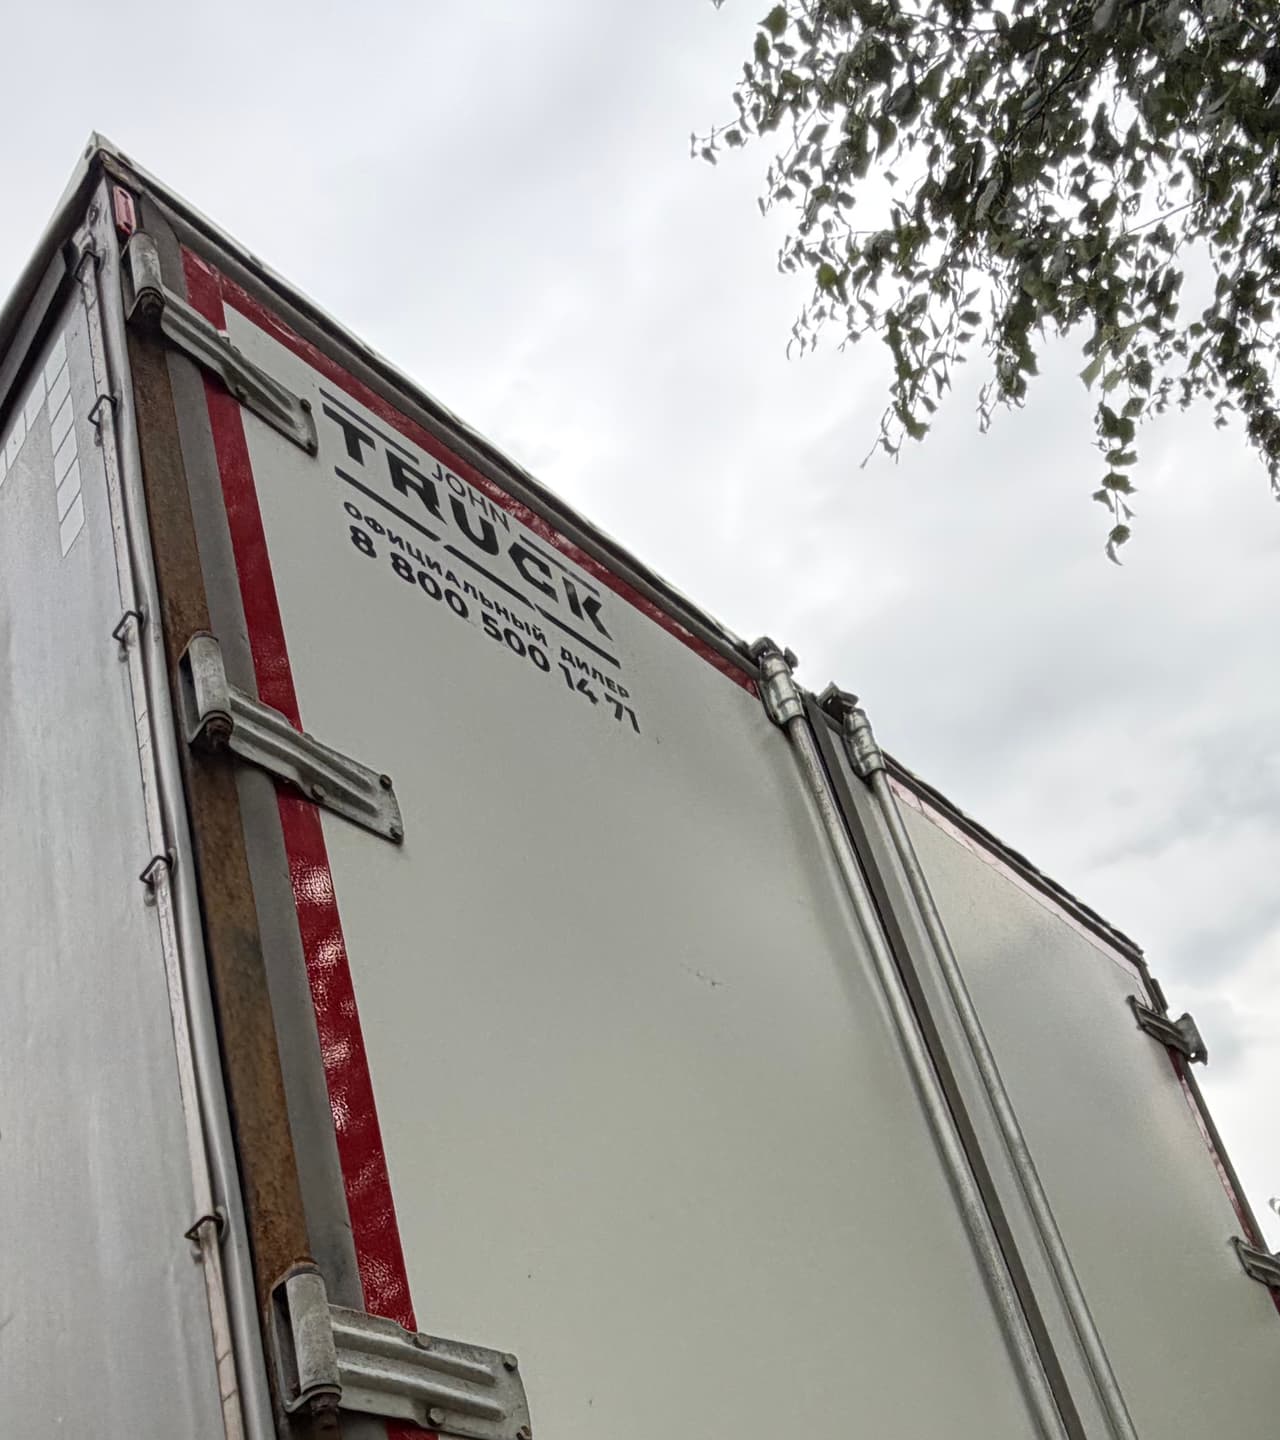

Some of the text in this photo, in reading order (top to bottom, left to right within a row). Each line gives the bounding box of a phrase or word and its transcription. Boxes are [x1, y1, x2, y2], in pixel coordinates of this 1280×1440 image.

[322, 402, 614, 642] TRUCK
[431, 463, 510, 533] JOHN
[344, 501, 630, 698] ОФИЦИАЛЬНЫЙ ДИЛЕР
[349, 524, 377, 559] 8
[390, 552, 469, 619] 800
[481, 611, 551, 673] 500
